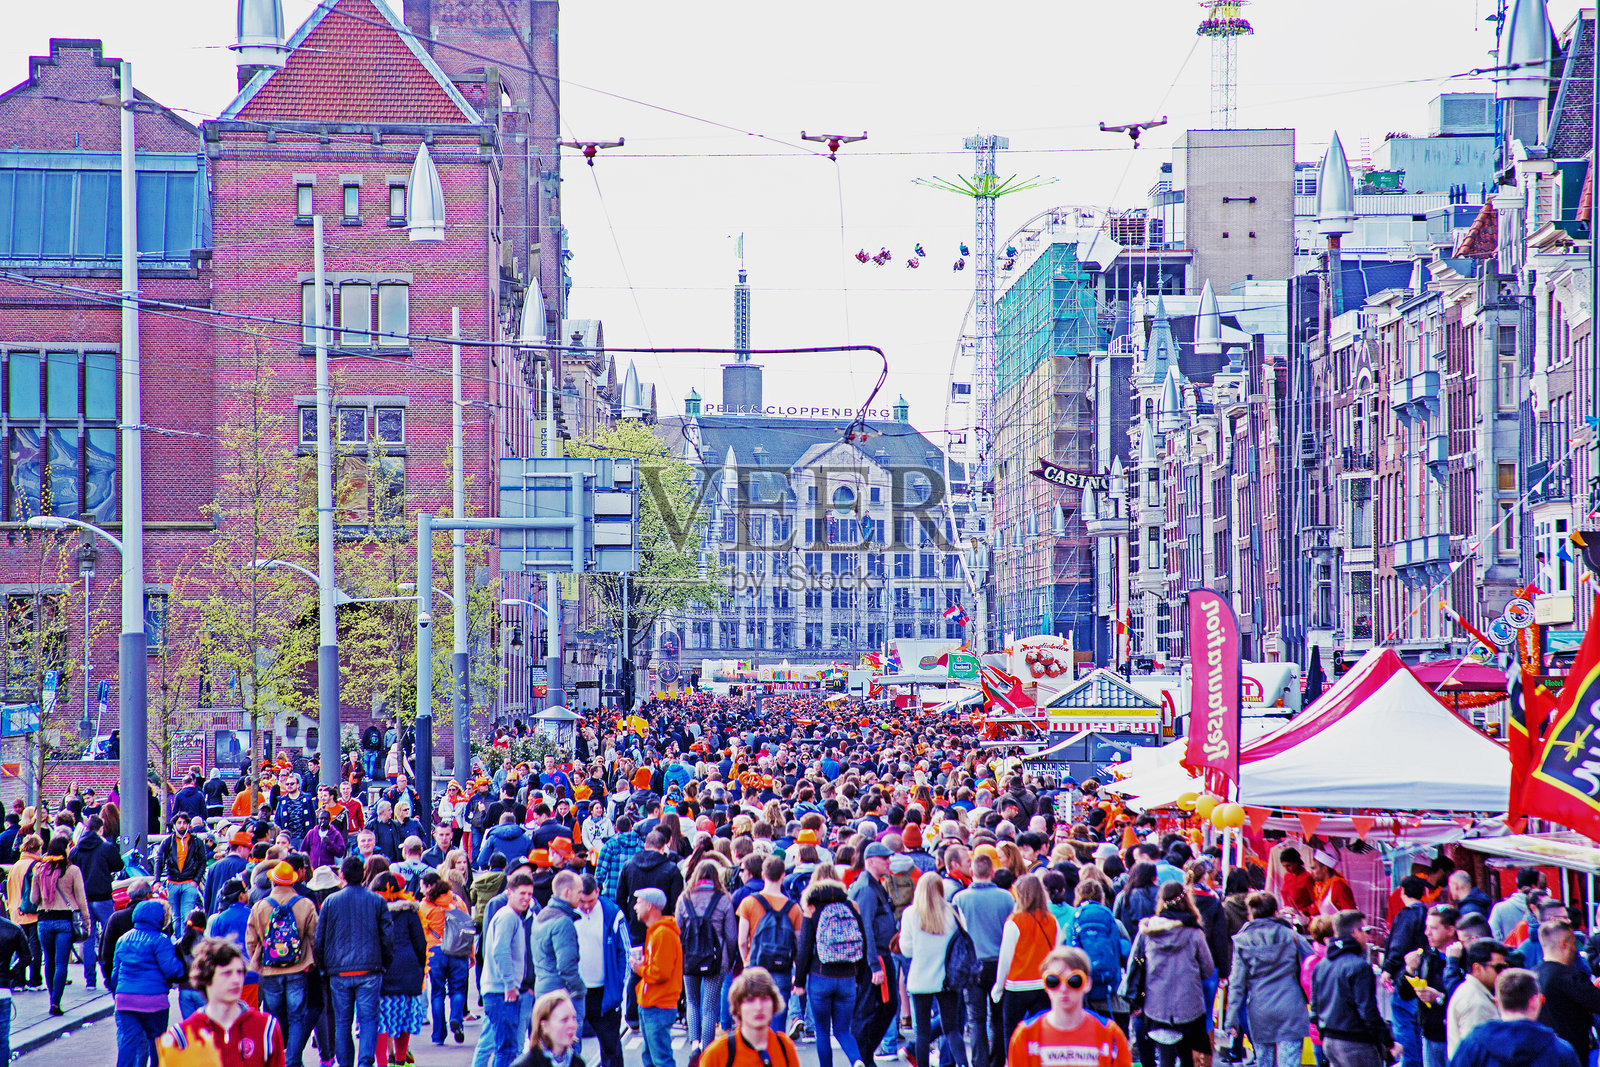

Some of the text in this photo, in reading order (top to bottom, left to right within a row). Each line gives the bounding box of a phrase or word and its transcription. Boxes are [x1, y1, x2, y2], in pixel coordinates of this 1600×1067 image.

[749, 404, 762, 414] &
[766, 405, 891, 418] CLOPPENBURG
[1544, 679, 1564, 687] Hotel
[1048, 1050, 1099, 1061] WARNIN
